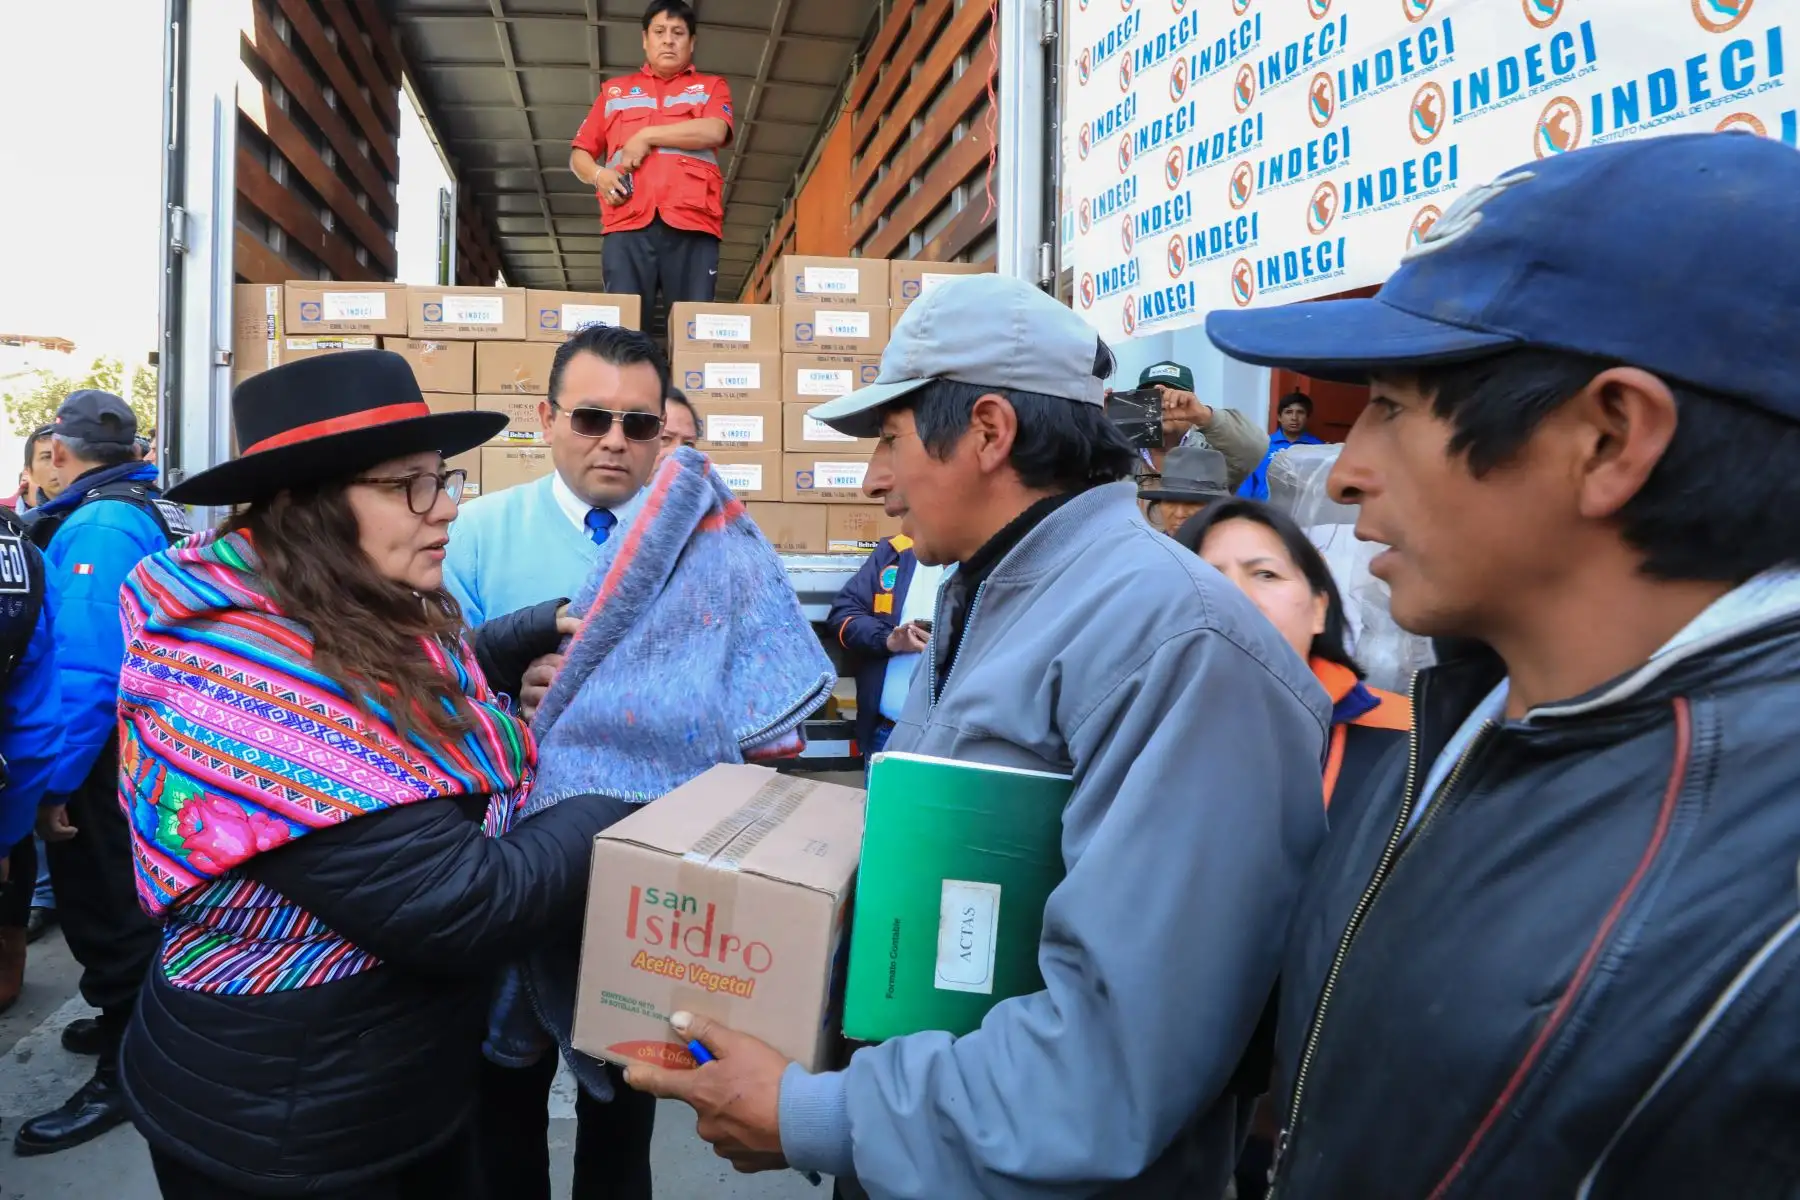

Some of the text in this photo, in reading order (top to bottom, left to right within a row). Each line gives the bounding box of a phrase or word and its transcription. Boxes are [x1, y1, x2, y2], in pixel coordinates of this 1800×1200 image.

[1092, 8, 1140, 67] INDECI
[1134, 9, 1198, 73] INDECI
[1191, 12, 1261, 80] INDECI
[1258, 13, 1347, 89] INDECI
[1338, 17, 1455, 101] INDECI
[1453, 20, 1597, 116] INDECI
[1591, 26, 1784, 136] INDECI
[1092, 91, 1136, 144] INDECI
[1133, 101, 1195, 155] INDECI
[1638, 110, 1686, 132] NACIONAL
[1689, 104, 1703, 115] DE
[1704, 88, 1754, 110] DEFENSA
[1756, 78, 1784, 93] CIVIL
[1187, 112, 1263, 171] INDECI
[1257, 126, 1350, 189] INDECI
[1093, 175, 1137, 219] INDECI
[1343, 144, 1458, 213] INDECI
[1135, 190, 1192, 239] INDECI
[1187, 211, 1259, 262] INDECI
[1096, 257, 1140, 295] INDECI
[1257, 236, 1346, 289] INDECI
[1138, 280, 1195, 320] INDECI
[625, 885, 773, 974] Isidro
[644, 887, 697, 914] san
[885, 917, 902, 1000] Formato Contable
[959, 906, 976, 963] ACTAS
[631, 949, 756, 999] Aceite Vegetal
